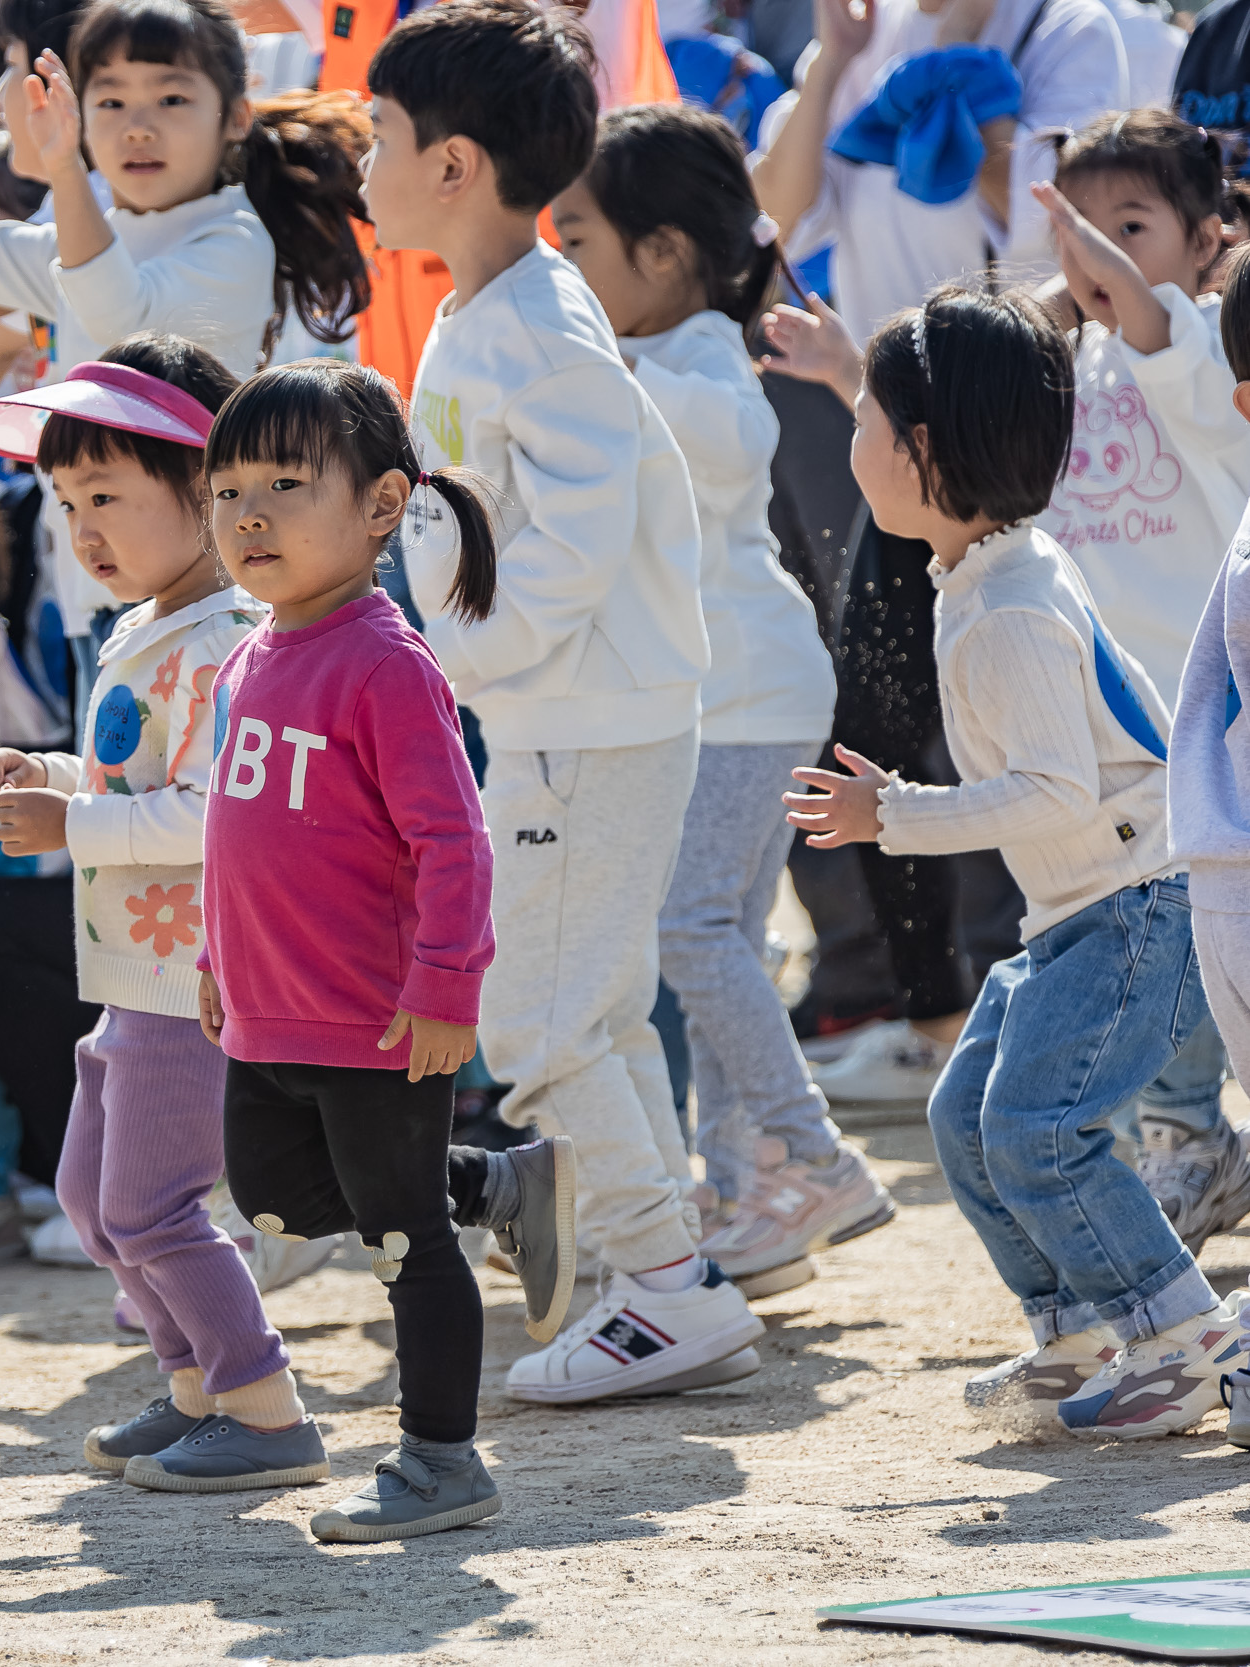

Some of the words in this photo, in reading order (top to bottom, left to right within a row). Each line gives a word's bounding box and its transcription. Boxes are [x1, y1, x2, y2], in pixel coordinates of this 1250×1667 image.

[1124, 508, 1177, 545] Chu
[516, 828, 558, 846] FILA
[1158, 1349, 1186, 1365] FILA
